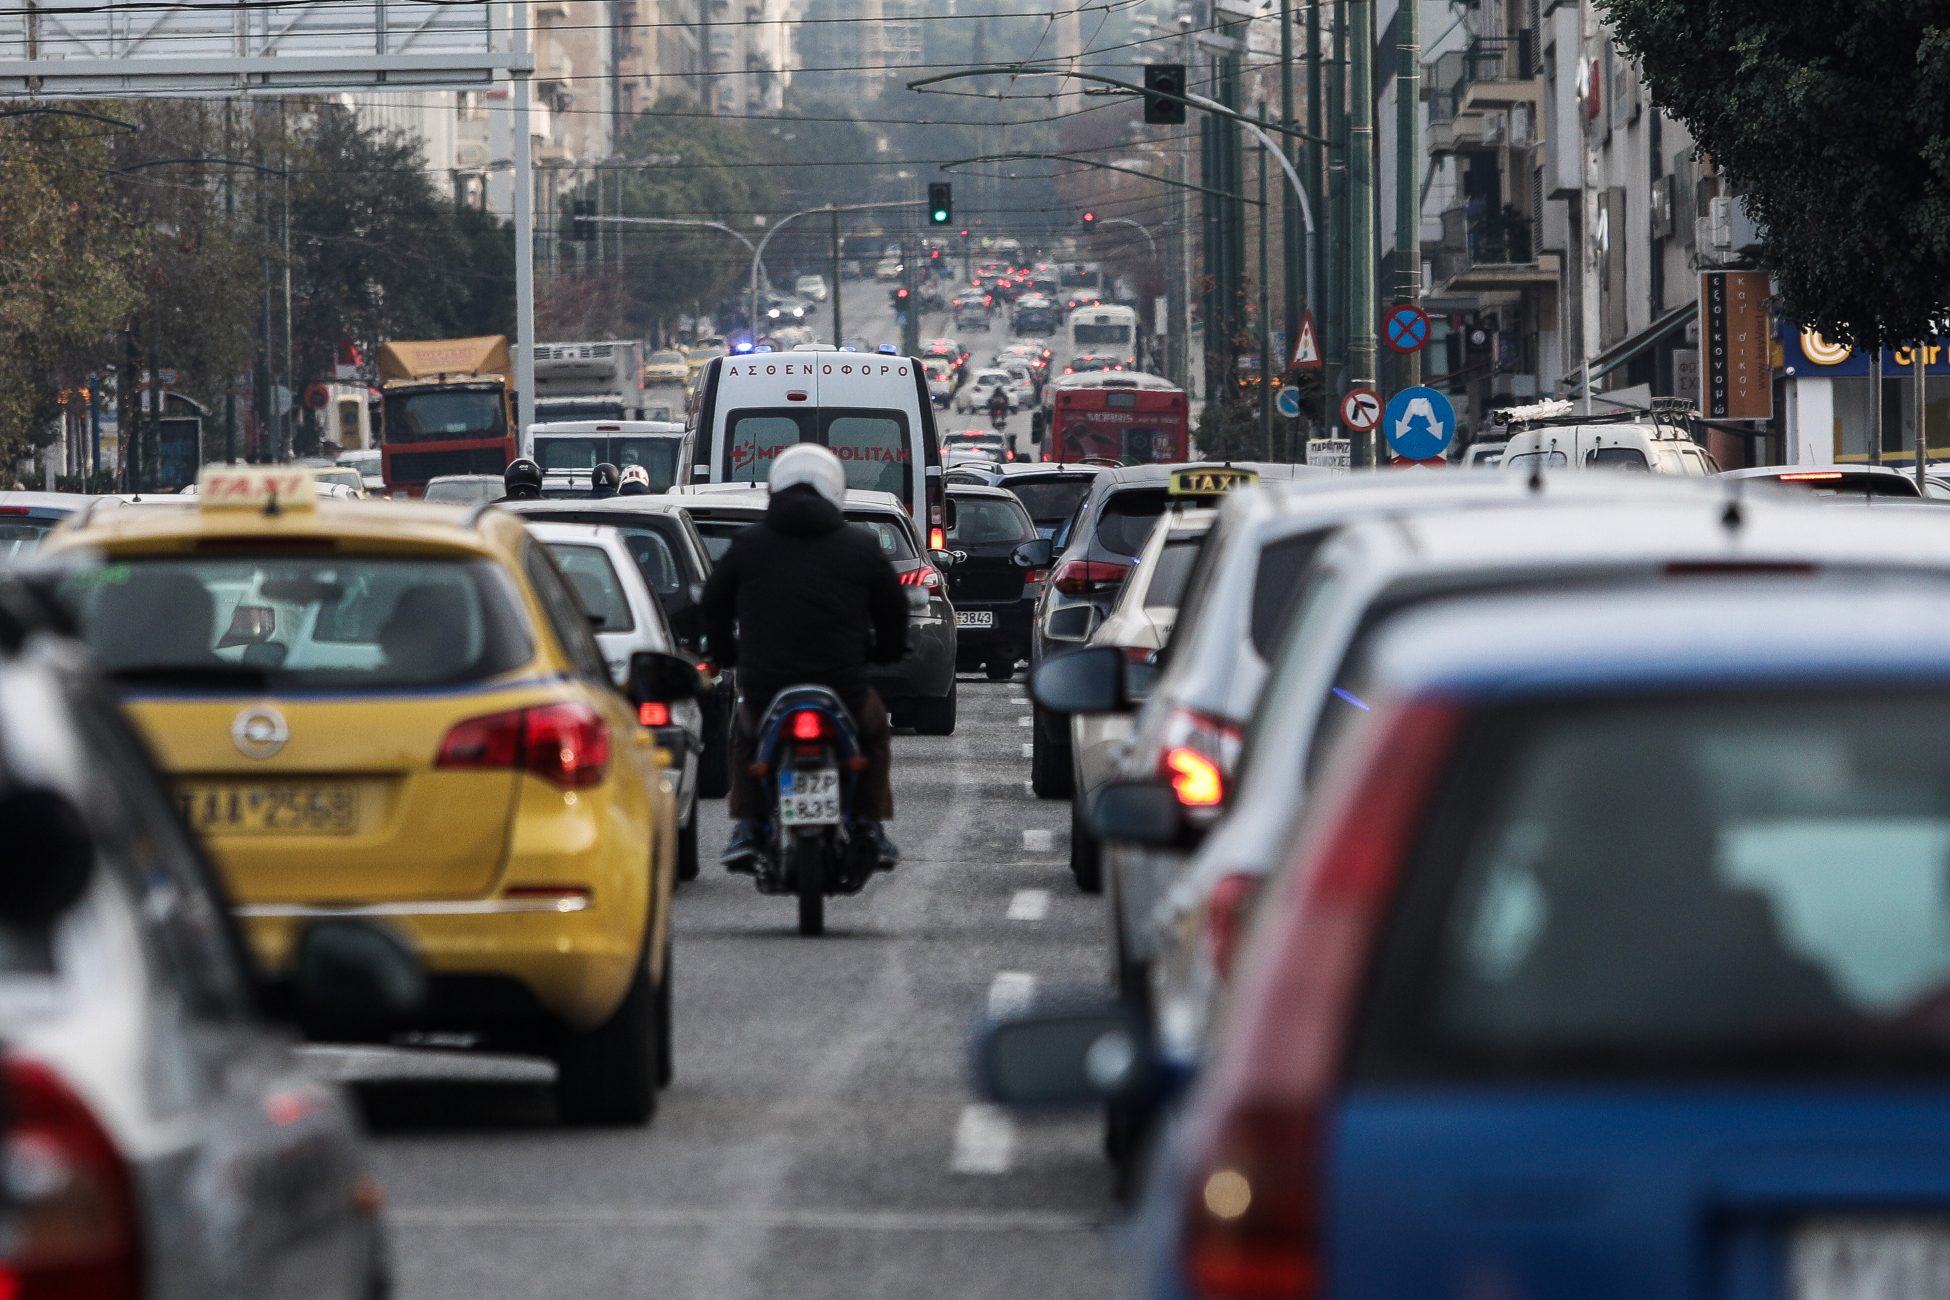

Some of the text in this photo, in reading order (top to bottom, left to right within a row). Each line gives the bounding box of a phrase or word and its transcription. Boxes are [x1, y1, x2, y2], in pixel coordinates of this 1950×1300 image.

[729, 364, 908, 377] ΑΣΘΕΝΟΦΟΡΟ
[757, 445, 910, 462] MEPOLITAN
[208, 476, 302, 497] TAXI
[1189, 475, 1240, 490] TAXI
